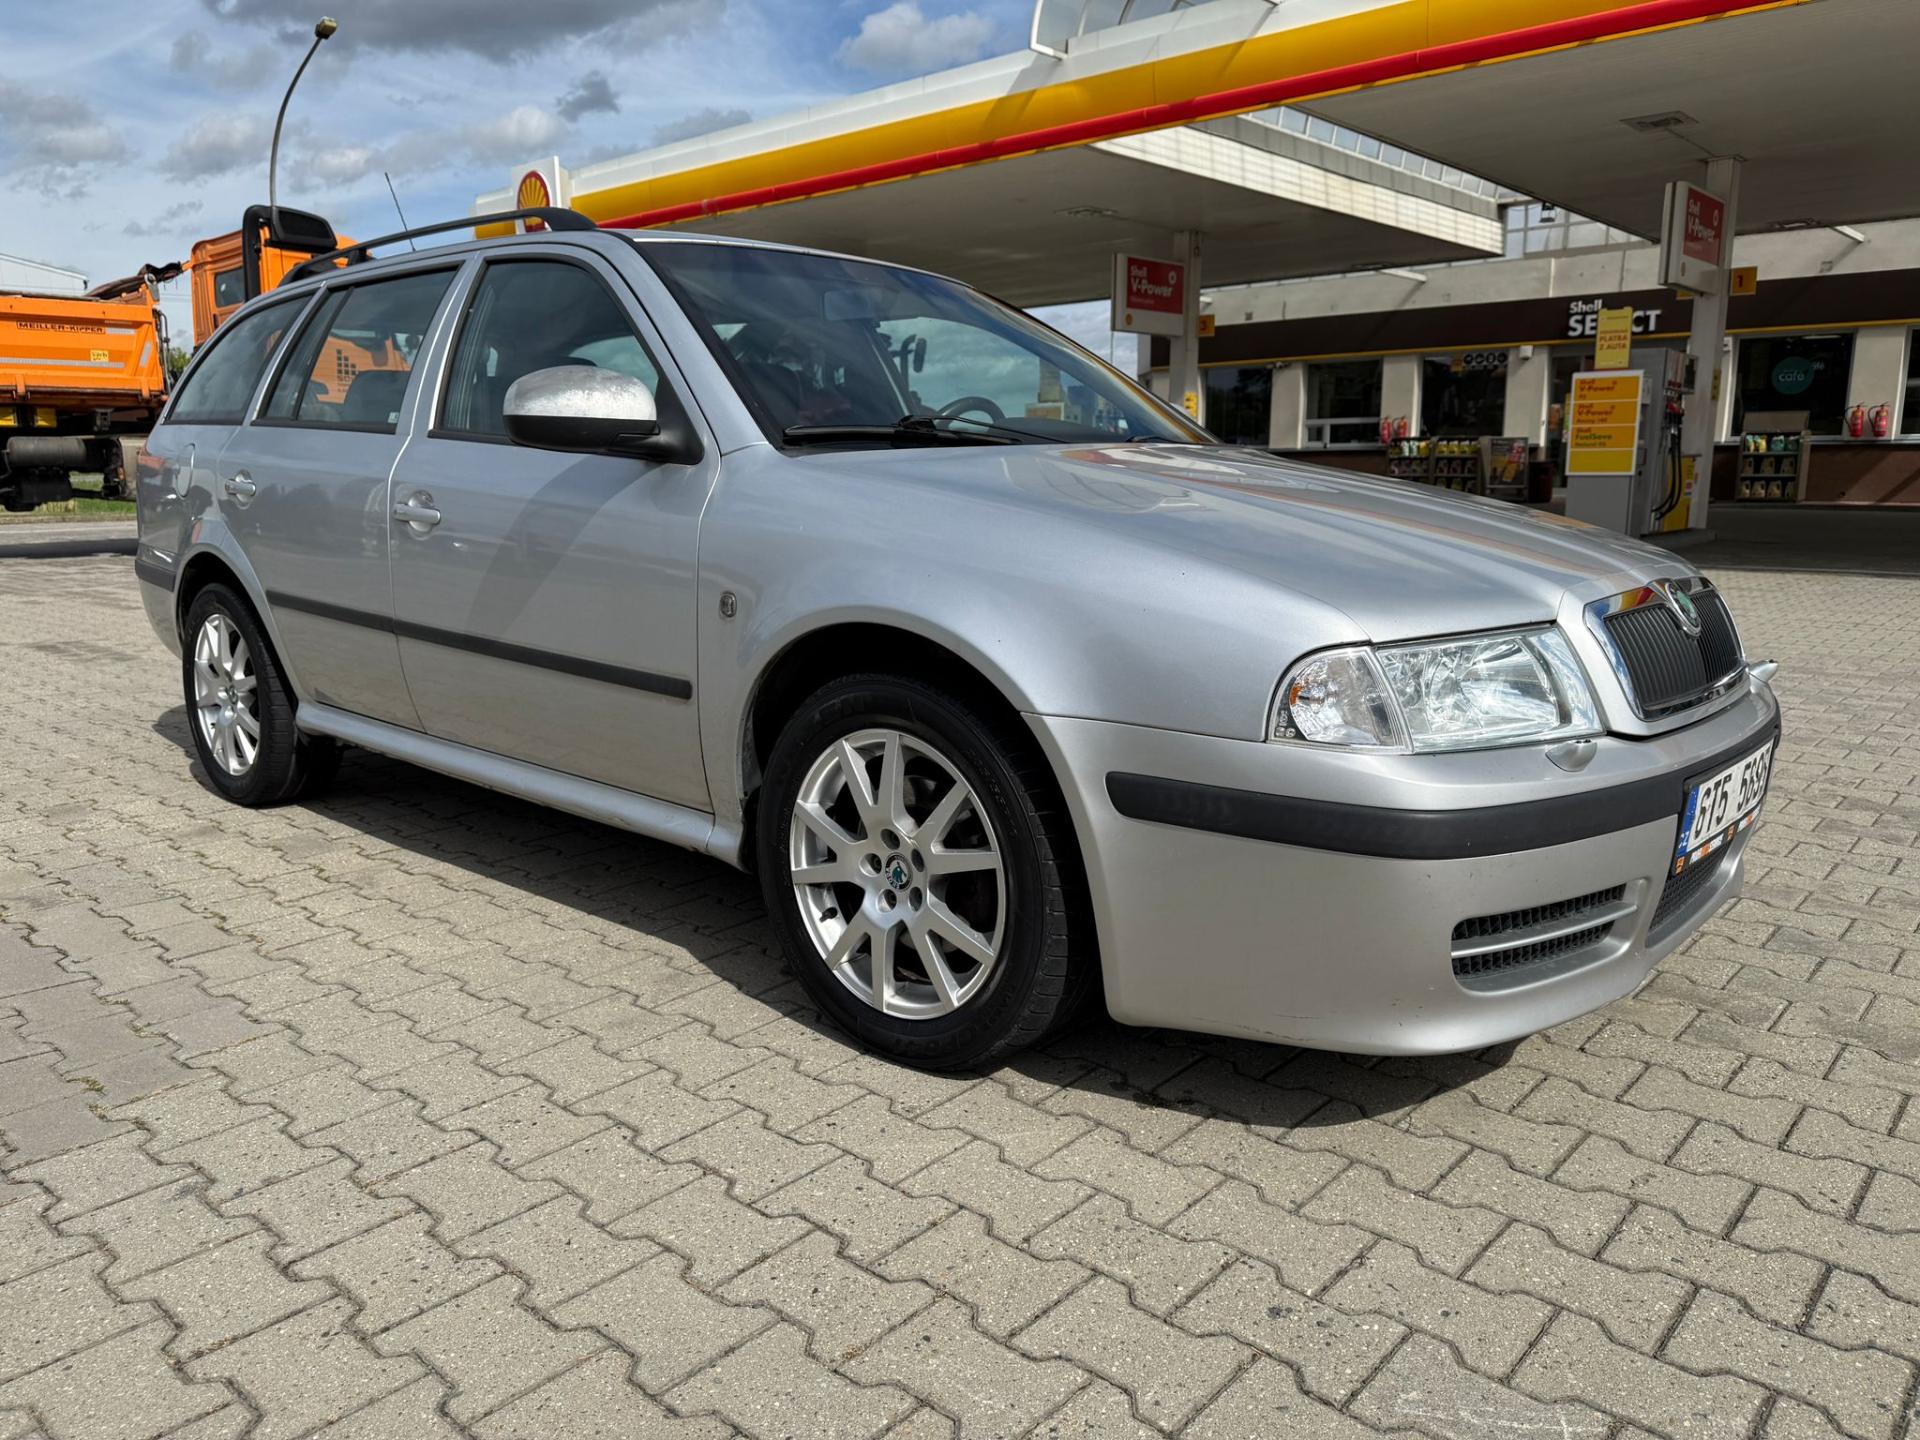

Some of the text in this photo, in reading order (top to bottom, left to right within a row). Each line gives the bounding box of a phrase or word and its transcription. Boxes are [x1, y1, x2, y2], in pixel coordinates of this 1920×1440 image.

[1131, 278, 1173, 297] V-Power
[1569, 299, 1602, 313] Shell
[19, 322, 103, 333] MEILLER-KIPPER
[1568, 309, 1662, 337] SECT
[1694, 773, 1733, 840] 6T5
